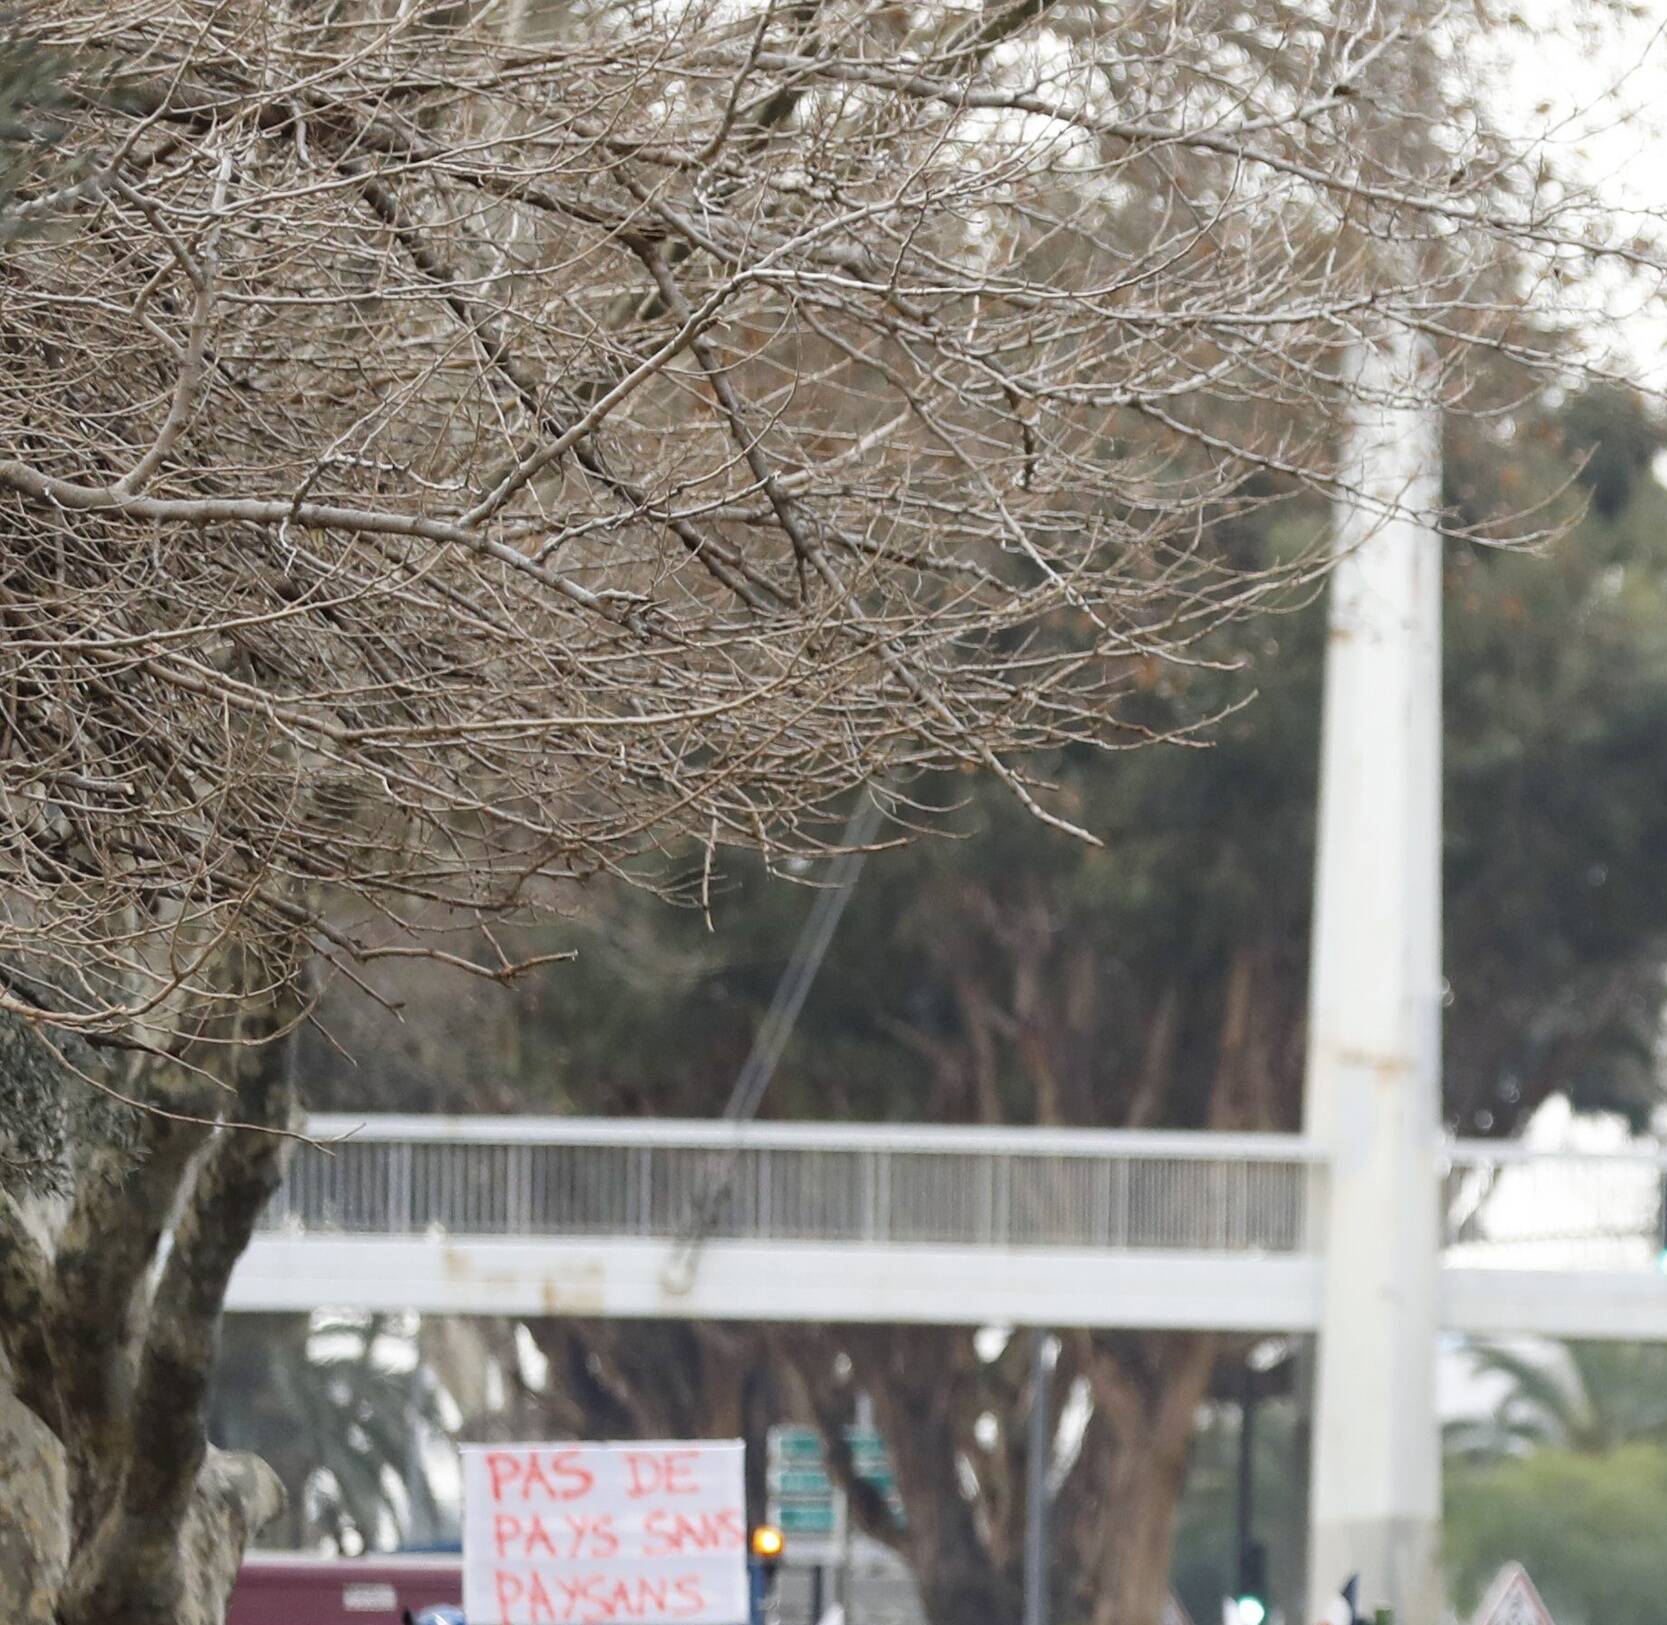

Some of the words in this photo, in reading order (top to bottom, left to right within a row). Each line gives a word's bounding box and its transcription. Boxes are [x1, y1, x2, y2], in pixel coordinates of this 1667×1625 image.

[485, 1446, 595, 1502] PAS
[624, 1449, 703, 1499] DE
[492, 1511, 622, 1559] PAYS
